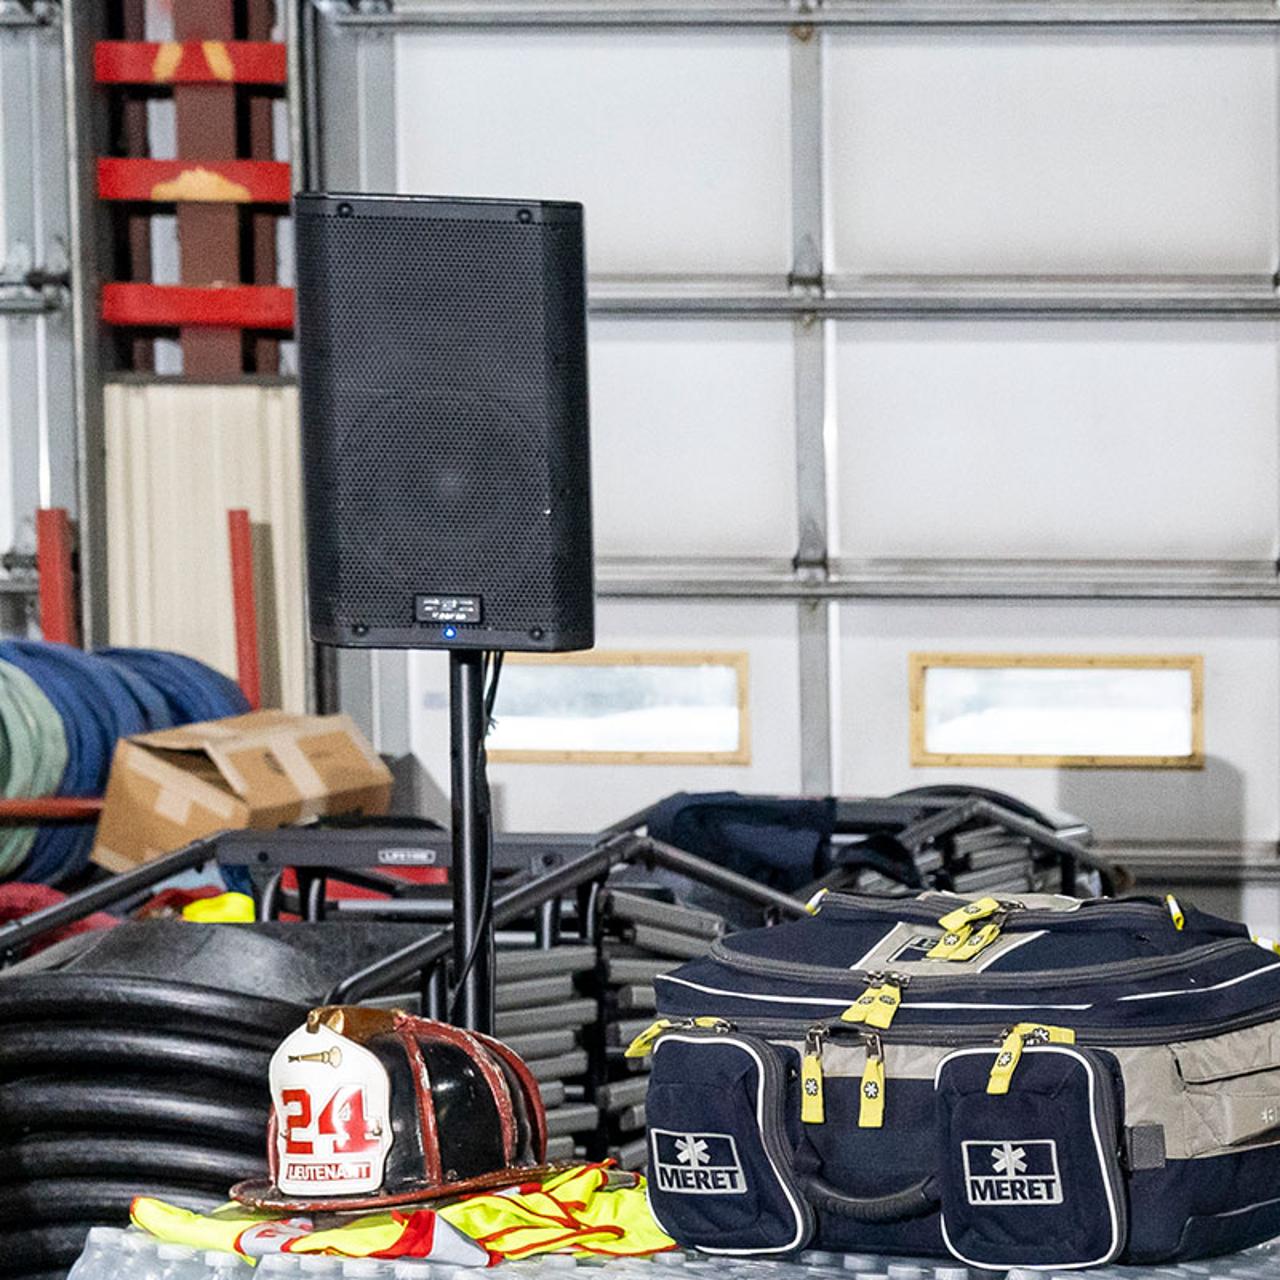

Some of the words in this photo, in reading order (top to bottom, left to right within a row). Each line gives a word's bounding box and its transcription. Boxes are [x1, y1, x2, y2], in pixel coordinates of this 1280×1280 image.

[281, 1087, 381, 1155] 24
[658, 1167, 739, 1190] MERET
[970, 1178, 1056, 1201] MERET
